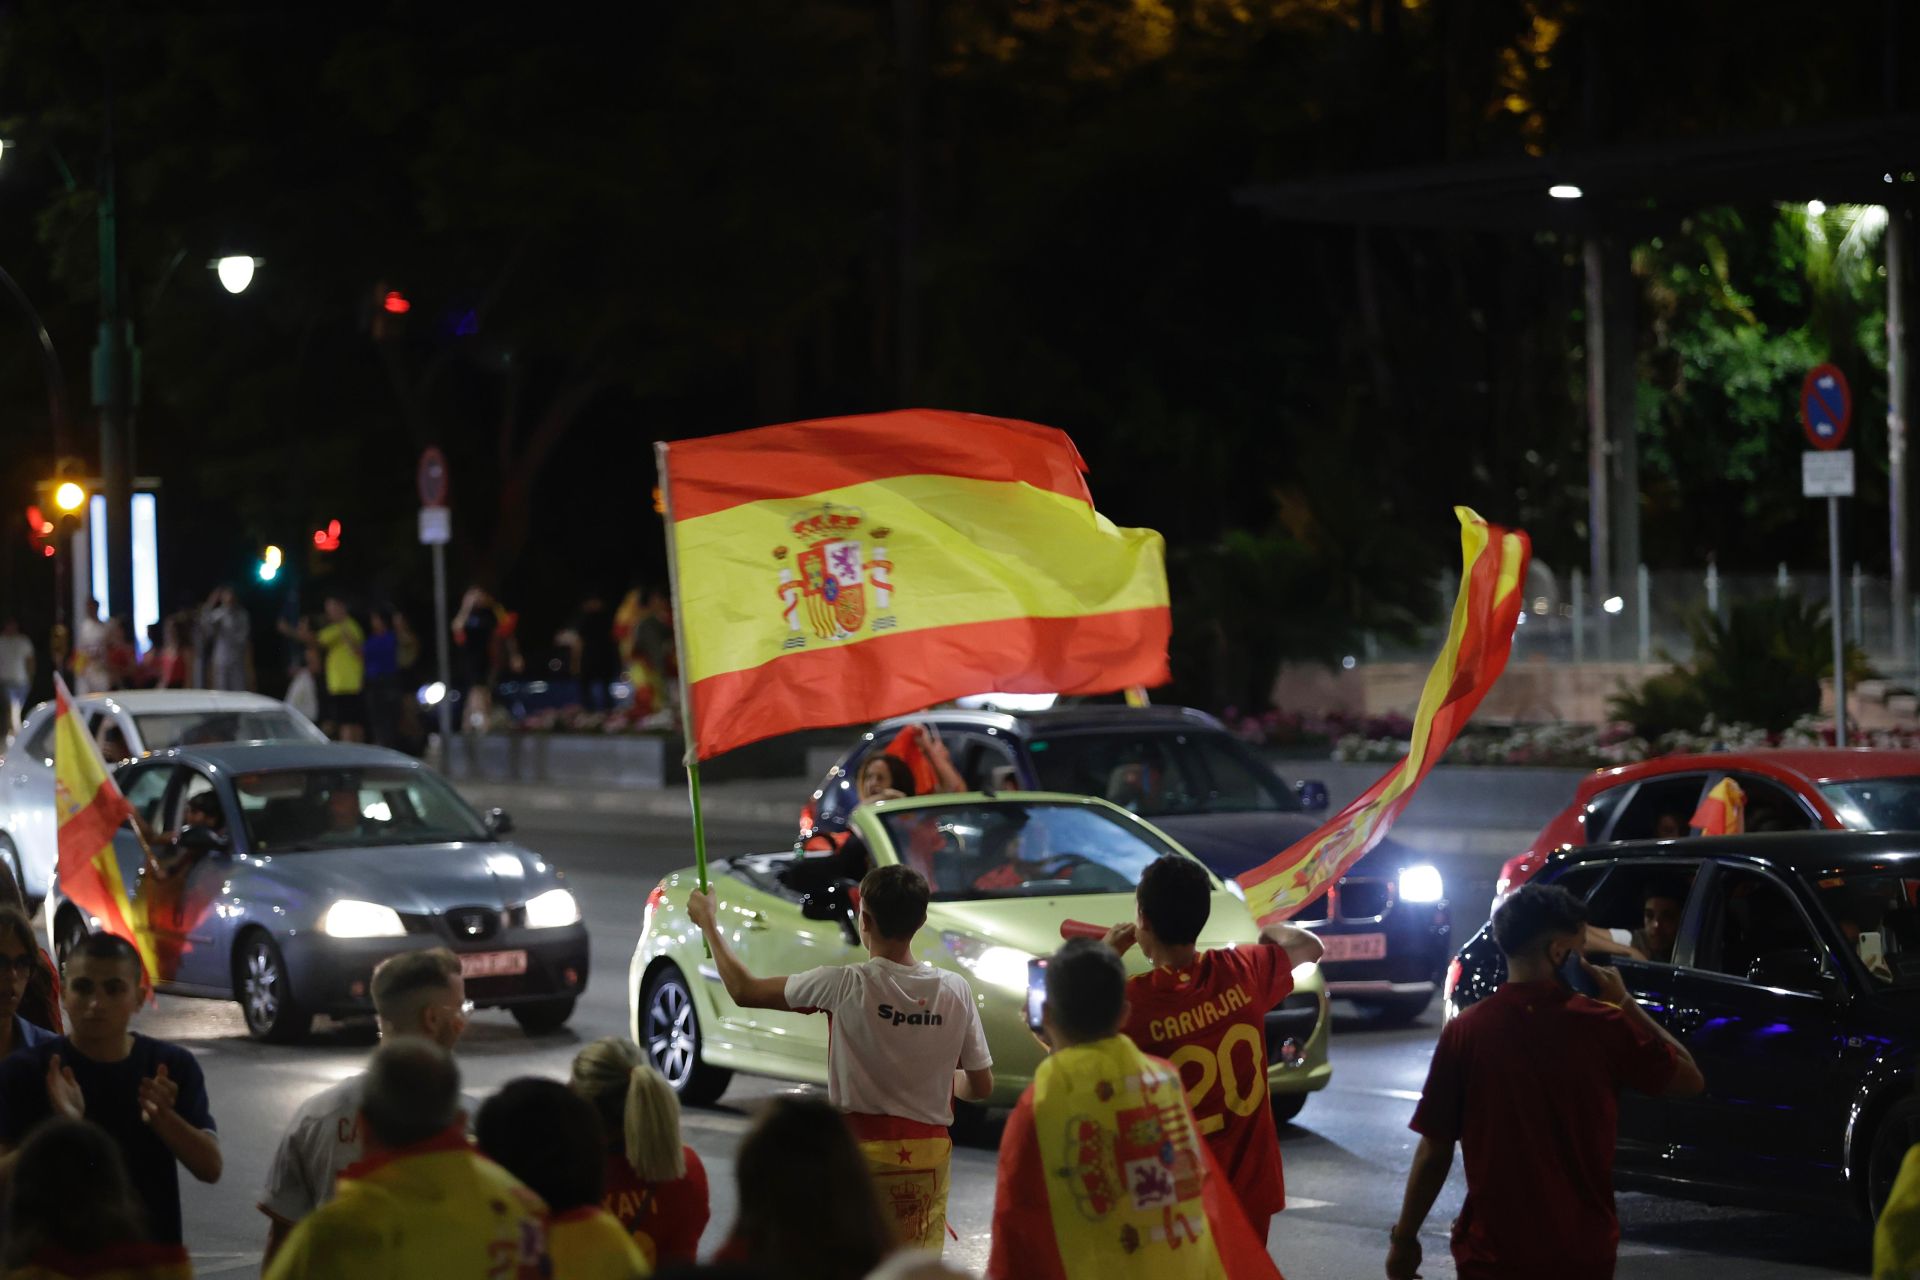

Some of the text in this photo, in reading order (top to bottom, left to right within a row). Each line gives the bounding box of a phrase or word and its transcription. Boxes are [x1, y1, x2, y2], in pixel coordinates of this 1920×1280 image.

[877, 1003, 943, 1027] Spain
[1150, 984, 1252, 1042] CARVAJAL
[1167, 1023, 1266, 1135] 20
